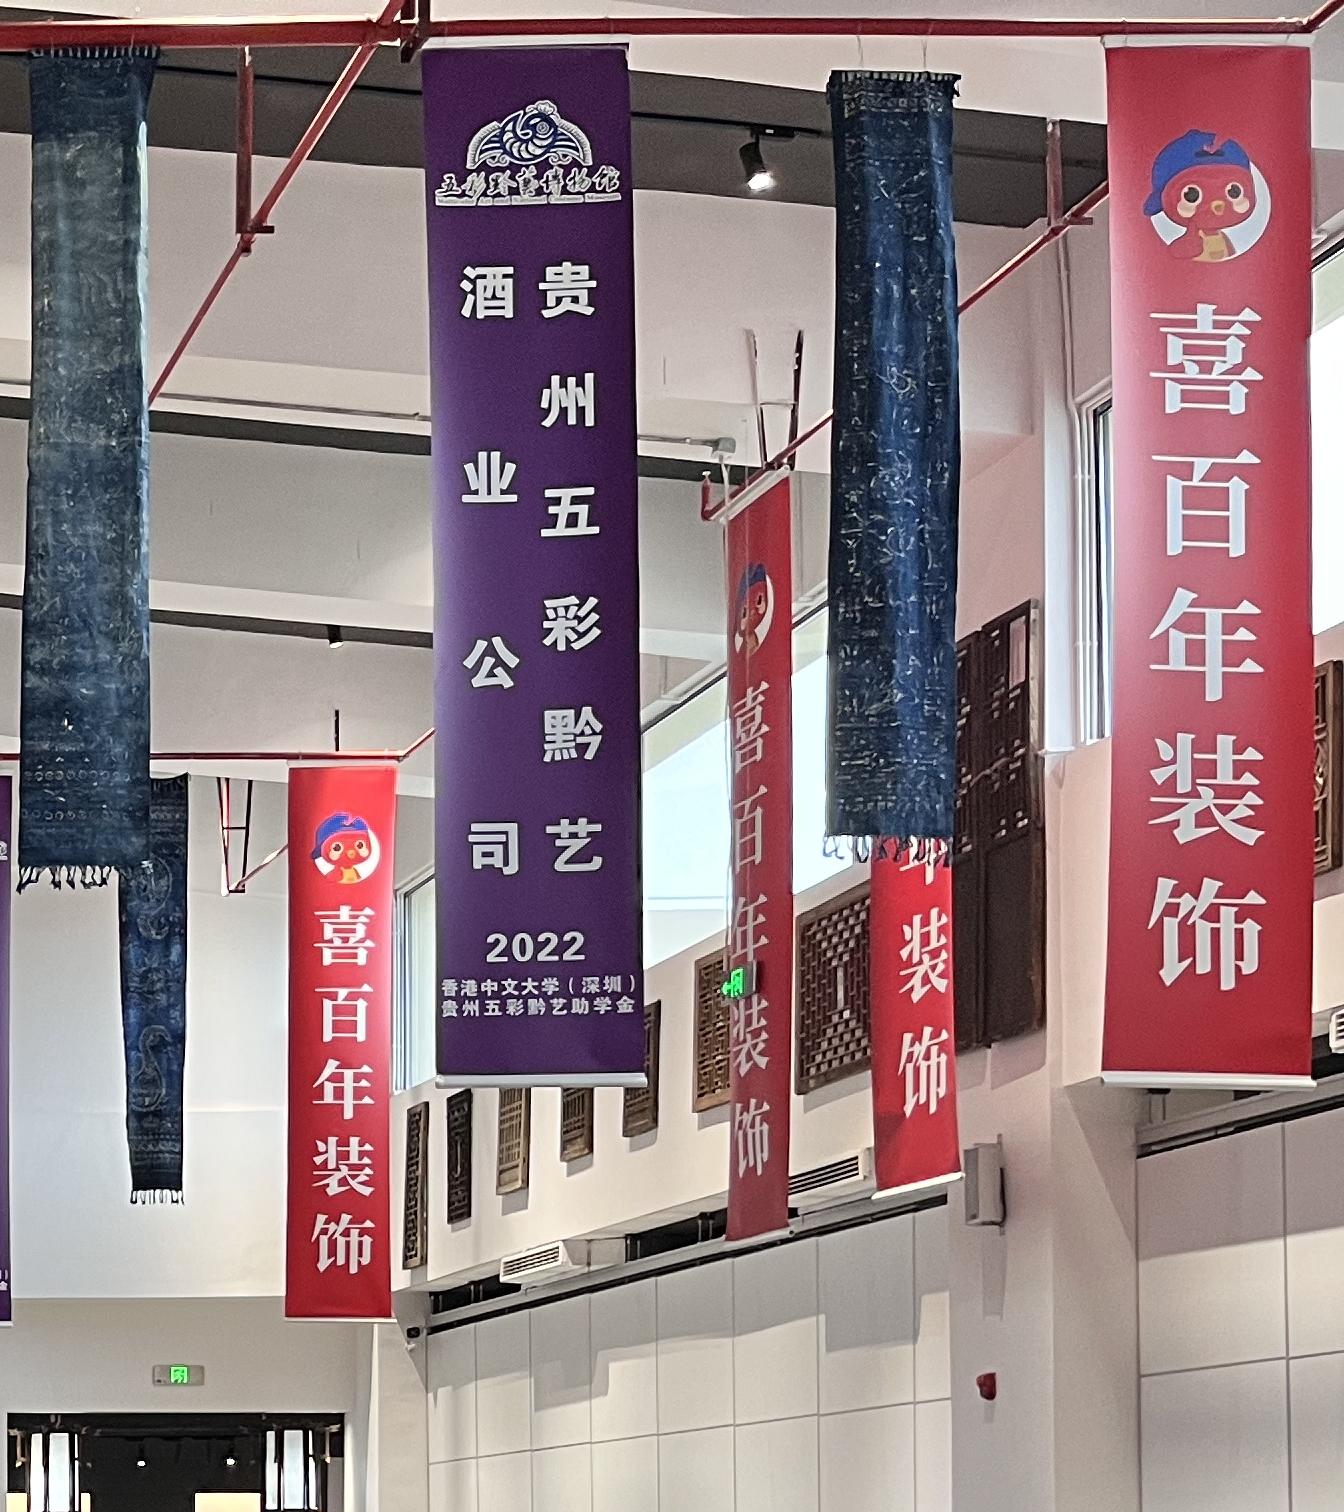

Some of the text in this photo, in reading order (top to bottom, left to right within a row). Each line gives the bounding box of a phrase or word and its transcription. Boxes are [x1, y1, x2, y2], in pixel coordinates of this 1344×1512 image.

[460, 266, 521, 875] 酒业公司
[538, 261, 603, 872] 贵州五彩黔艺
[1148, 302, 1266, 991] 喜百年装饰
[312, 905, 376, 1275] 喜百年装饰
[486, 931, 585, 963] 2022
[731, 681, 770, 1179] 喜百年装饰
